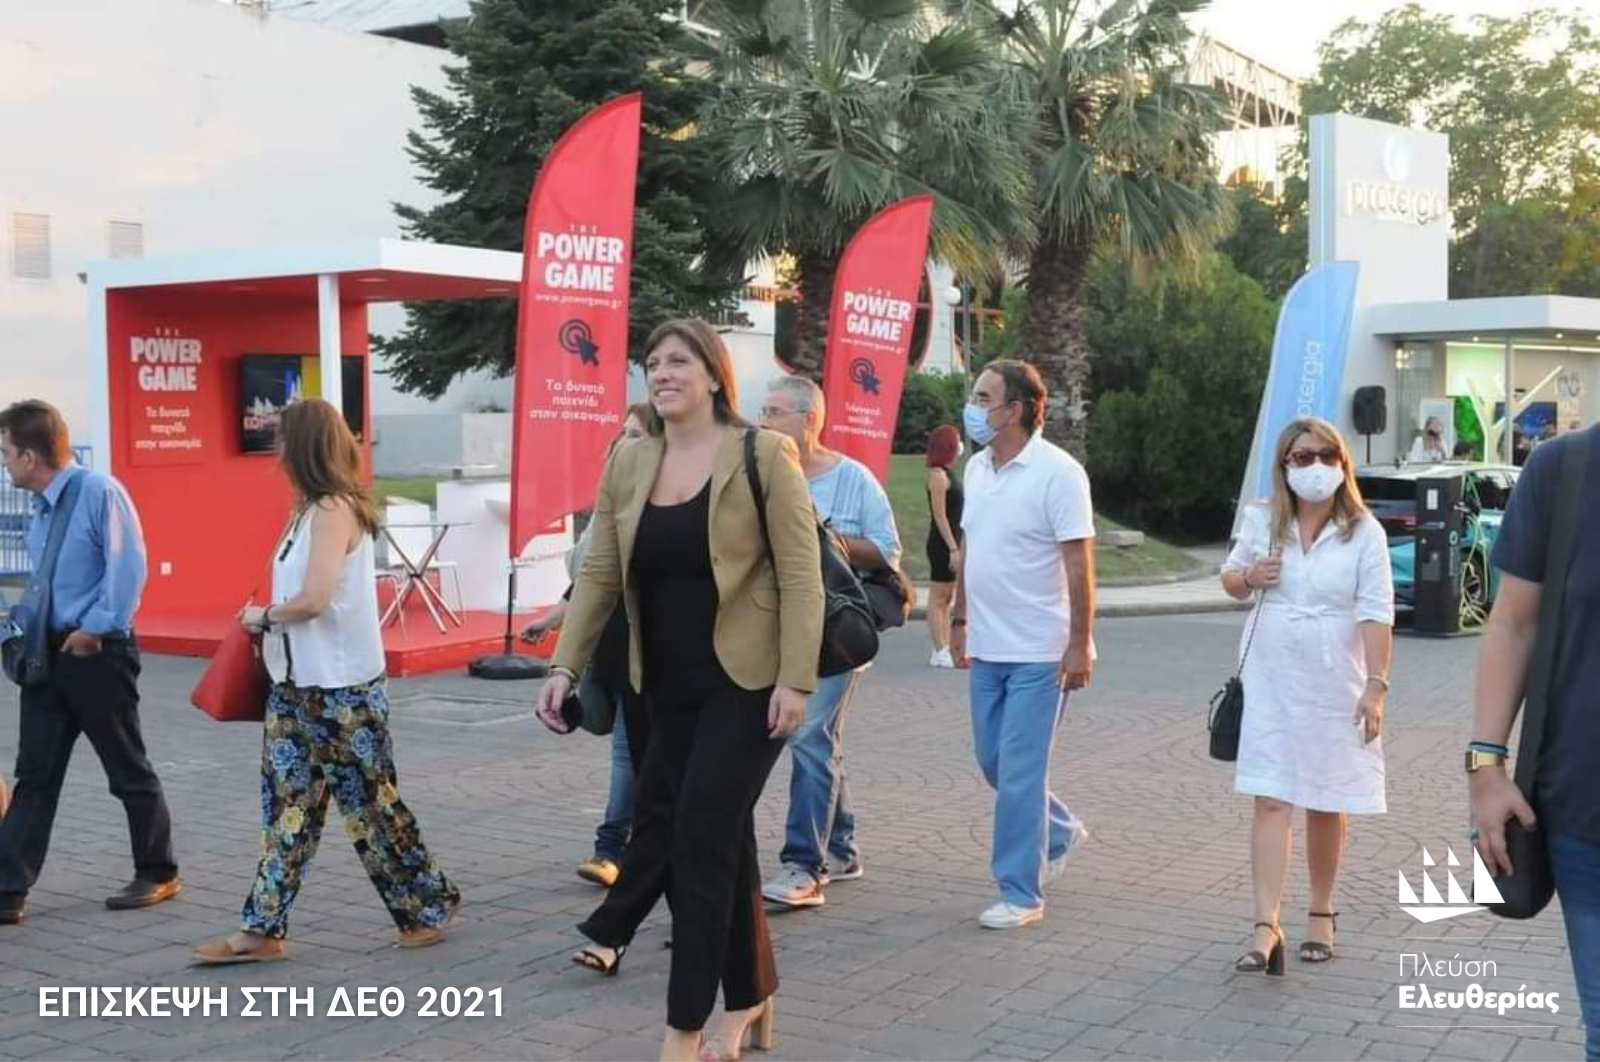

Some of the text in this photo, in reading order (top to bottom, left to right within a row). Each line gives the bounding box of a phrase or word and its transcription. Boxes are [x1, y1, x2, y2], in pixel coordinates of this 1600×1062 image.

[537, 231, 624, 263] POWER
[544, 261, 615, 292] GAME
[843, 290, 912, 321] POWER
[846, 313, 902, 342] GAME
[130, 336, 202, 363] POWER
[138, 365, 198, 391] GAME
[546, 379, 562, 391] Το
